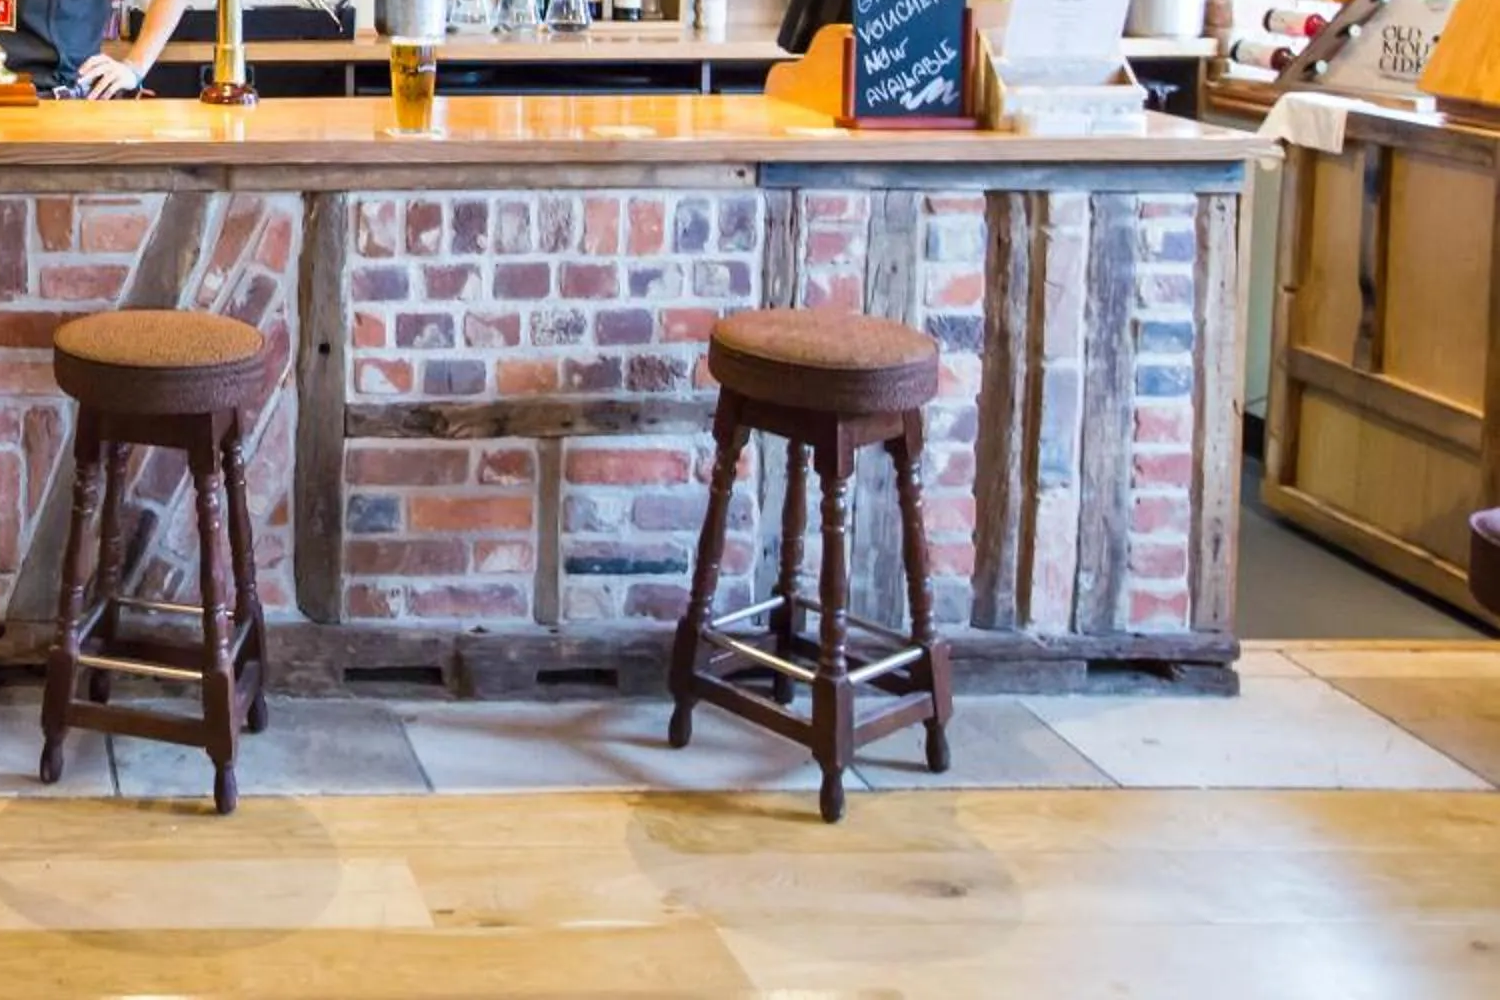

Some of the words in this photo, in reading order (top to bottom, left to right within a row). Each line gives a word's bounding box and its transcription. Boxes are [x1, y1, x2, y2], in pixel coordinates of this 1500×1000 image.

[1383, 25, 1422, 41] OLD
[1383, 40, 1430, 57] MOU
[1379, 56, 1426, 72] CIDE
[866, 38, 958, 108] AVAILABLE
